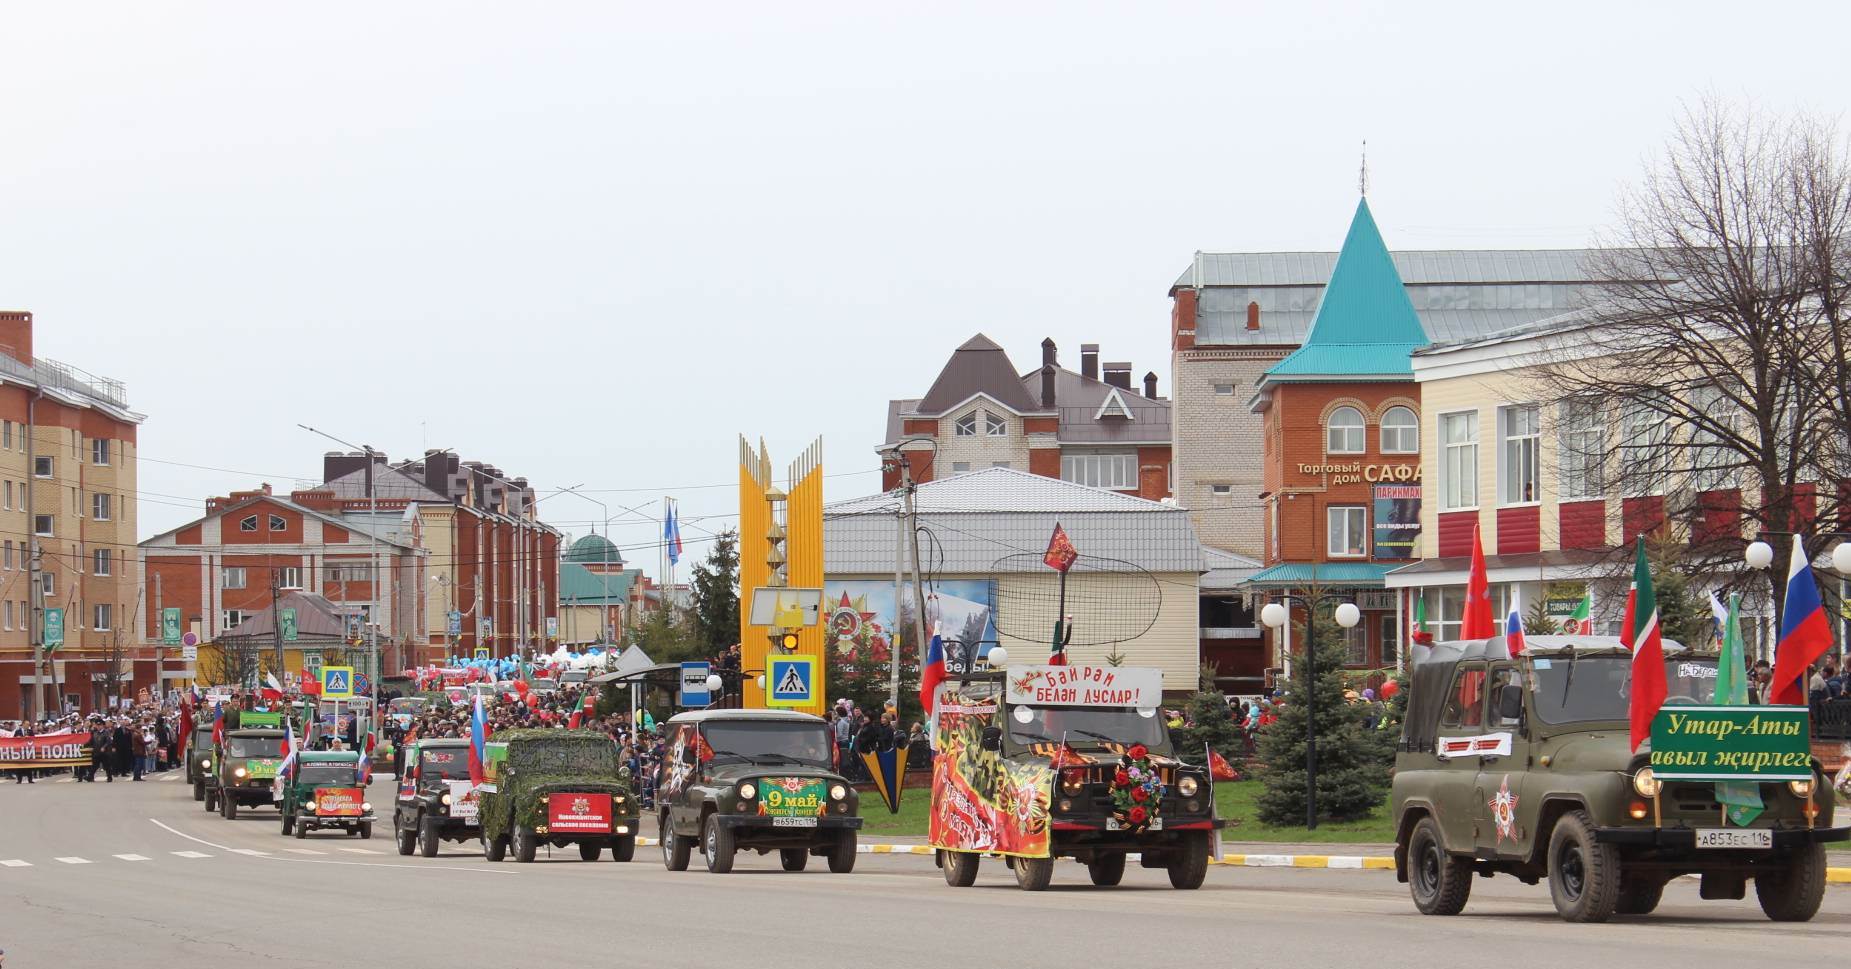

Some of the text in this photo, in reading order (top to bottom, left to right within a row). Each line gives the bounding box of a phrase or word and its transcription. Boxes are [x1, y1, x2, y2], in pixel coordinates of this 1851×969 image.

[1297, 462, 1360, 475] Торговый
[1377, 487, 1422, 498] ПАРИКМАХ
[1083, 688, 1139, 704] ДУСЛАР!
[1668, 714, 1800, 741] Утар-Аты
[41, 743, 83, 759] ПОЛК
[1651, 750, 1707, 766] авыл
[768, 790, 817, 807] 9 май
